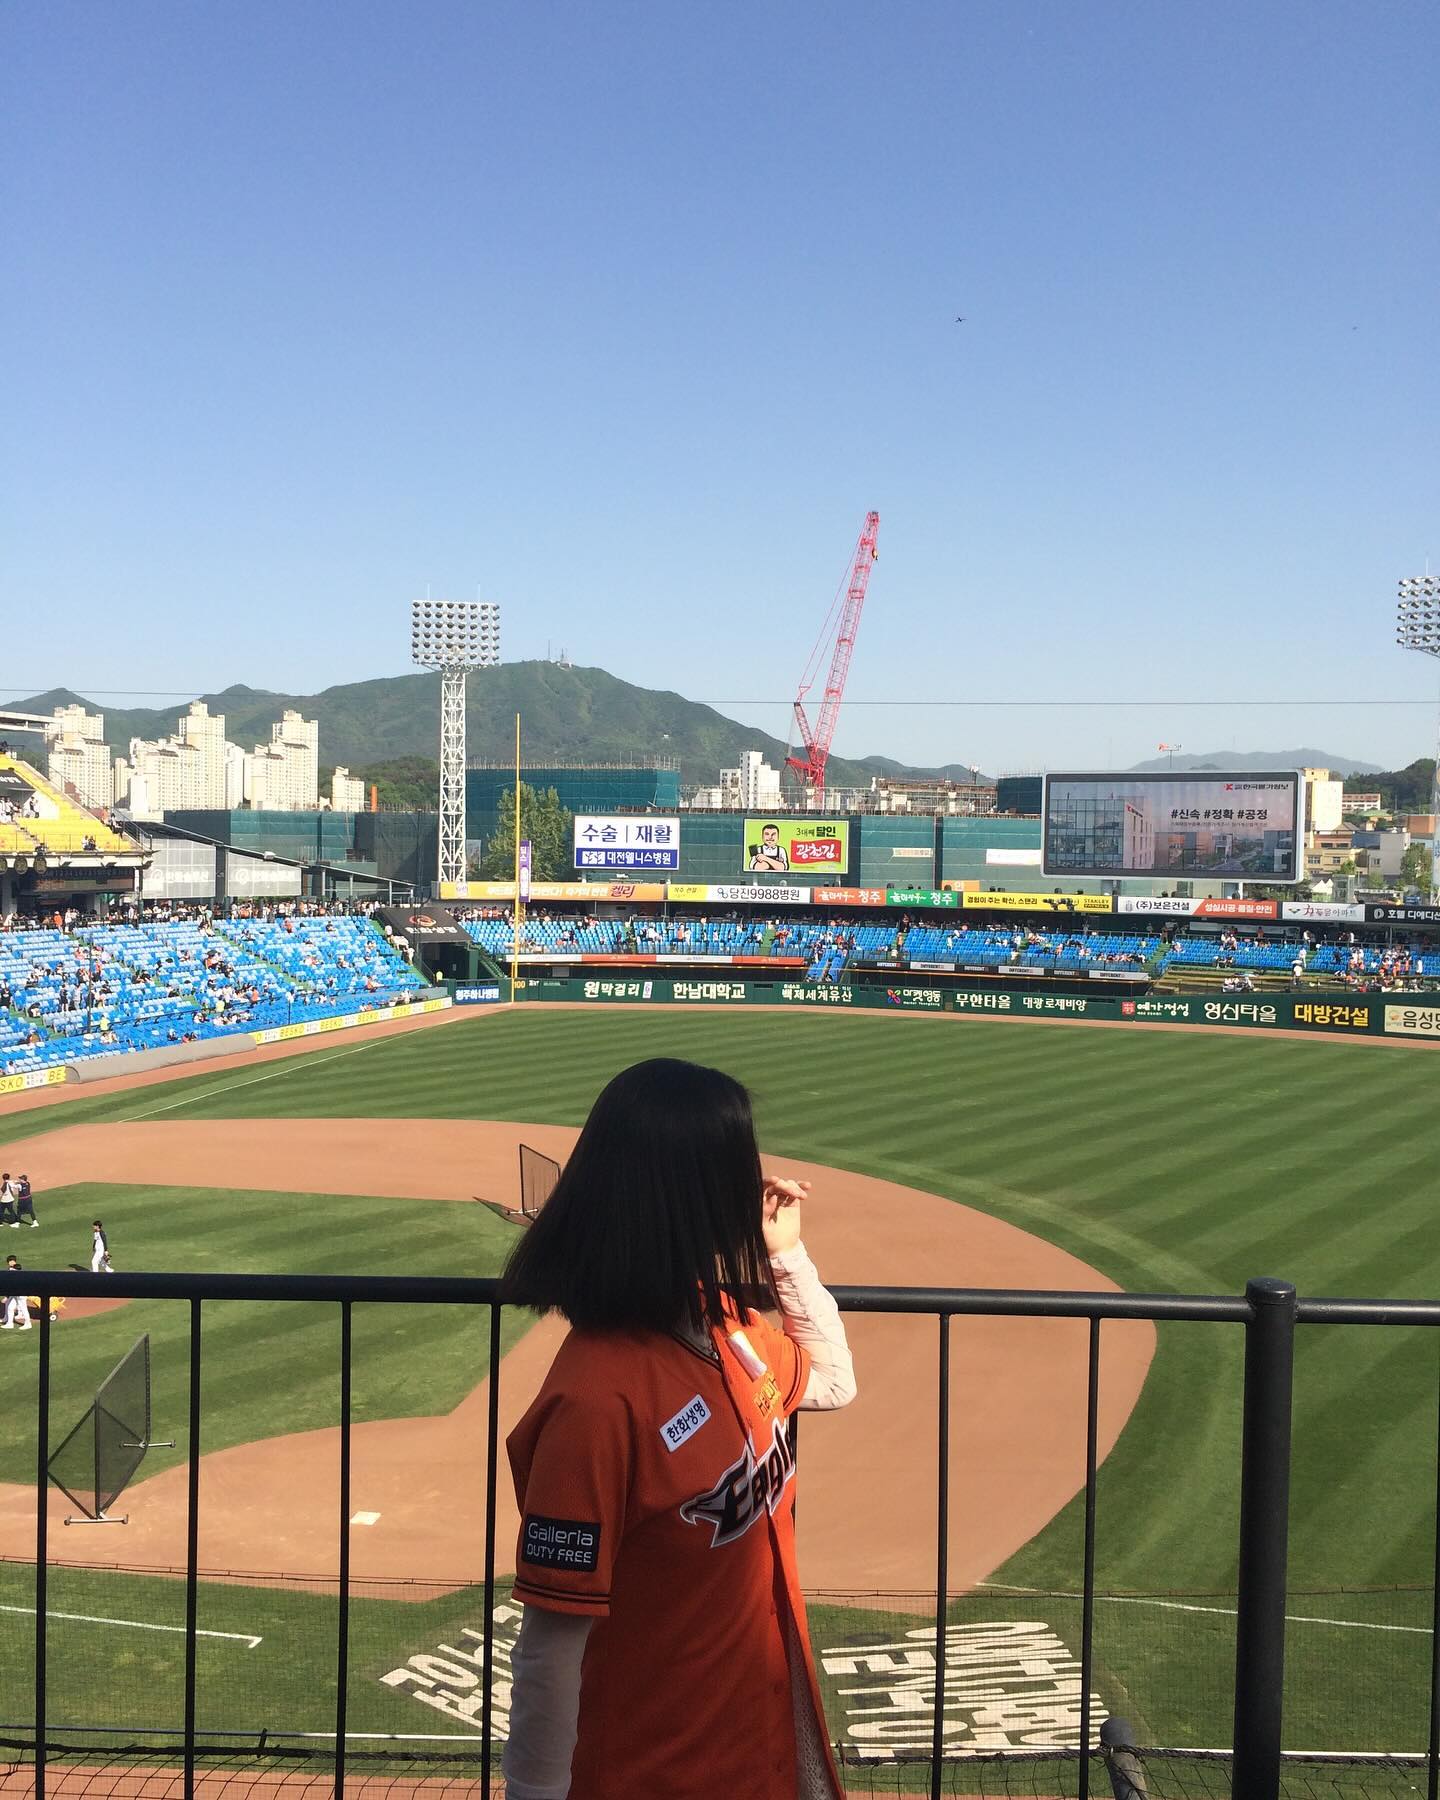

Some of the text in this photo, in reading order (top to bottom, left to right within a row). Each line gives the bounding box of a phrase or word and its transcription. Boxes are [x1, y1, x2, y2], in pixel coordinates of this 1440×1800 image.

[1170, 809, 1268, 821] #신속 #정확 #공정
[582, 824, 673, 844] 수술 재활
[816, 826, 836, 838] 달인
[607, 851, 672, 865] 대전웰니스병원
[796, 843, 836, 860] 광천김
[611, 885, 636, 898] 켈리
[729, 888, 800, 901] 당진9988병원
[858, 891, 881, 903] 청주
[930, 892, 953, 905] 청주
[1136, 900, 1190, 911] (주)보은건설
[1388, 910, 1405, 919] 호텔
[455, 988, 499, 1000] 청주하나병원
[584, 981, 640, 998] 원막걸리
[673, 982, 746, 1000] 한남대학교
[782, 988, 853, 1003] 백제세계유산
[956, 993, 1011, 1009] 무한타올
[1204, 1002, 1278, 1023] 영신타올
[1294, 1004, 1369, 1027] 대방건설
[0, 1076, 24, 1091] SKO
[667, 1402, 706, 1444] 한화생명
[528, 1522, 594, 1546] Galleria
[526, 1543, 592, 1564] DUTY FREE
